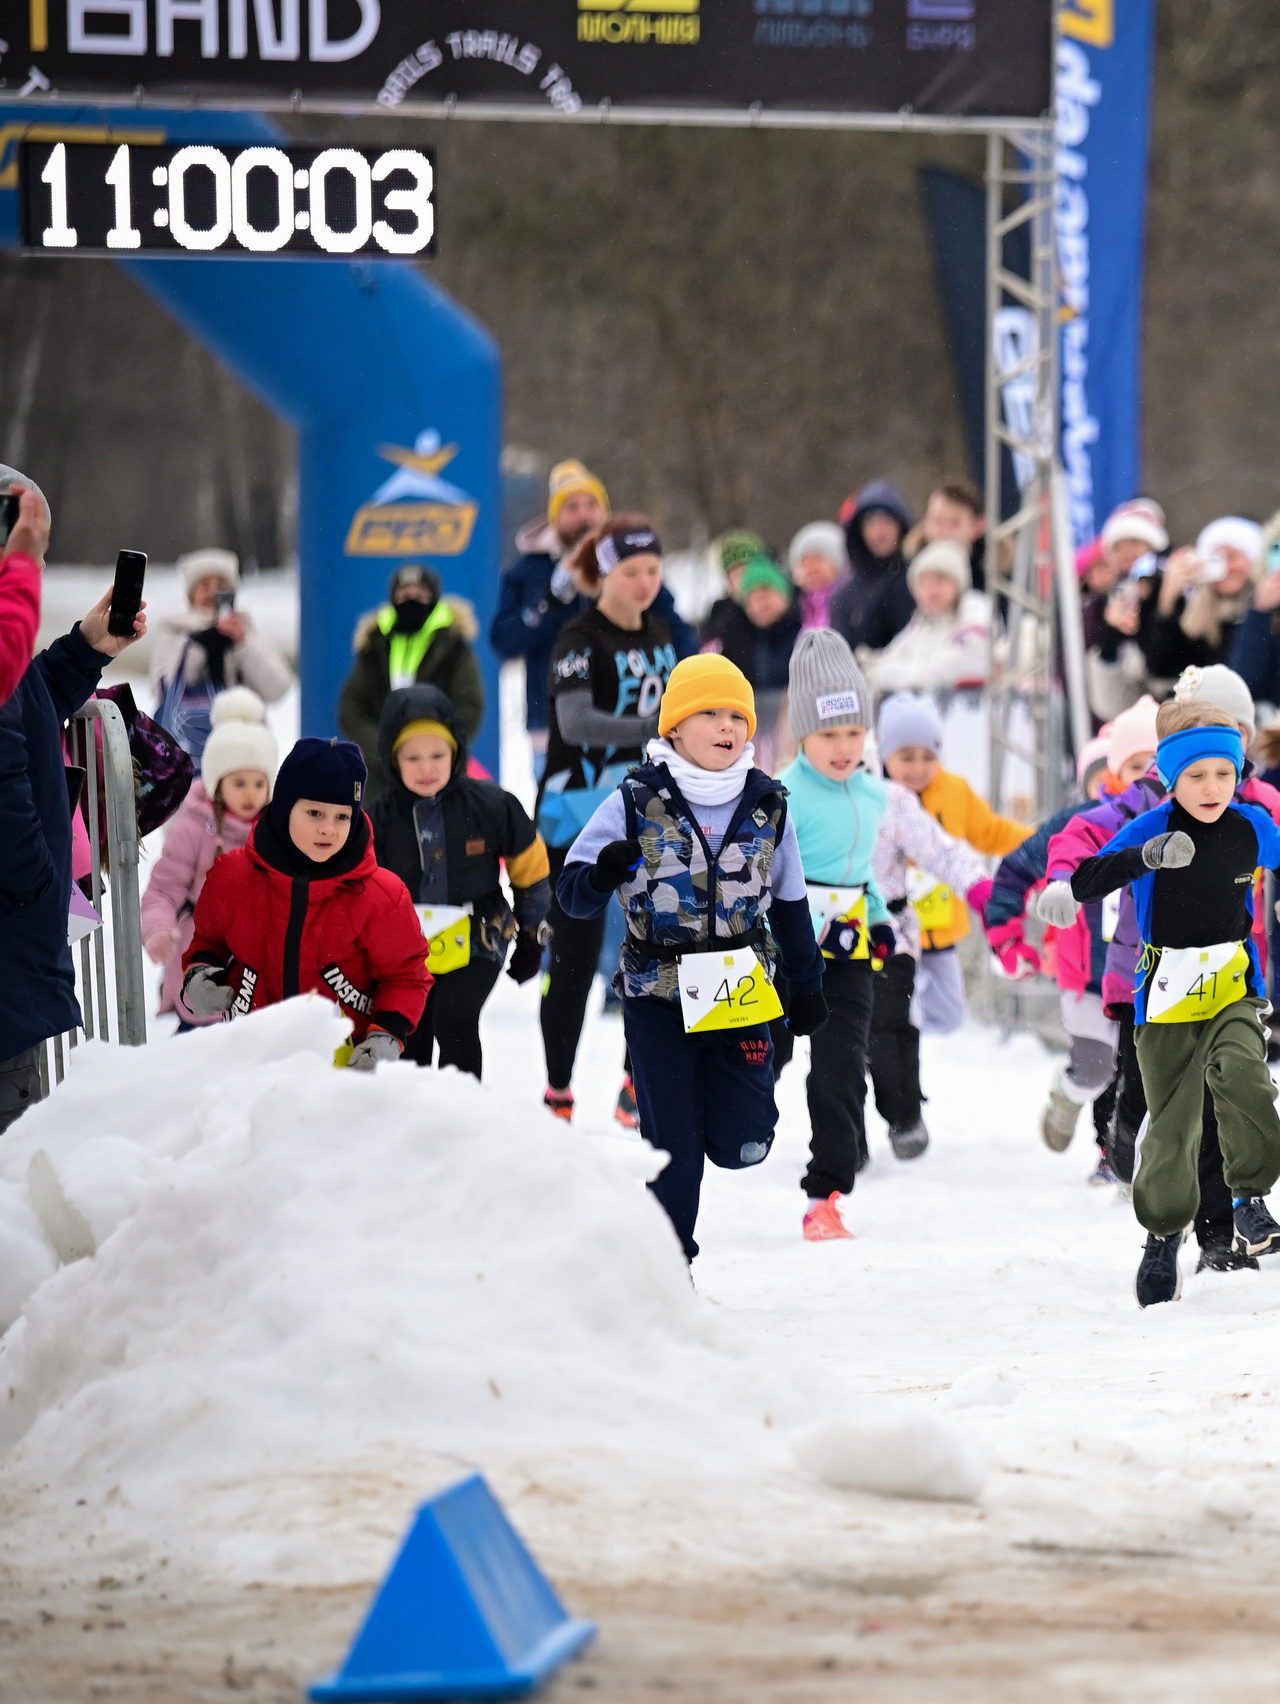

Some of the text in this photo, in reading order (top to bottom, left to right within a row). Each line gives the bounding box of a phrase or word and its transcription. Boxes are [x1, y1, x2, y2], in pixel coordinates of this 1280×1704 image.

[376, 39, 443, 108] RAILS
[540, 62, 582, 114] TRA
[613, 675, 664, 719] FO
[225, 967, 257, 1022] REME
[713, 975, 759, 1008] 42
[1186, 971, 1219, 1002] 41
[740, 1039, 770, 1052] ROAD
